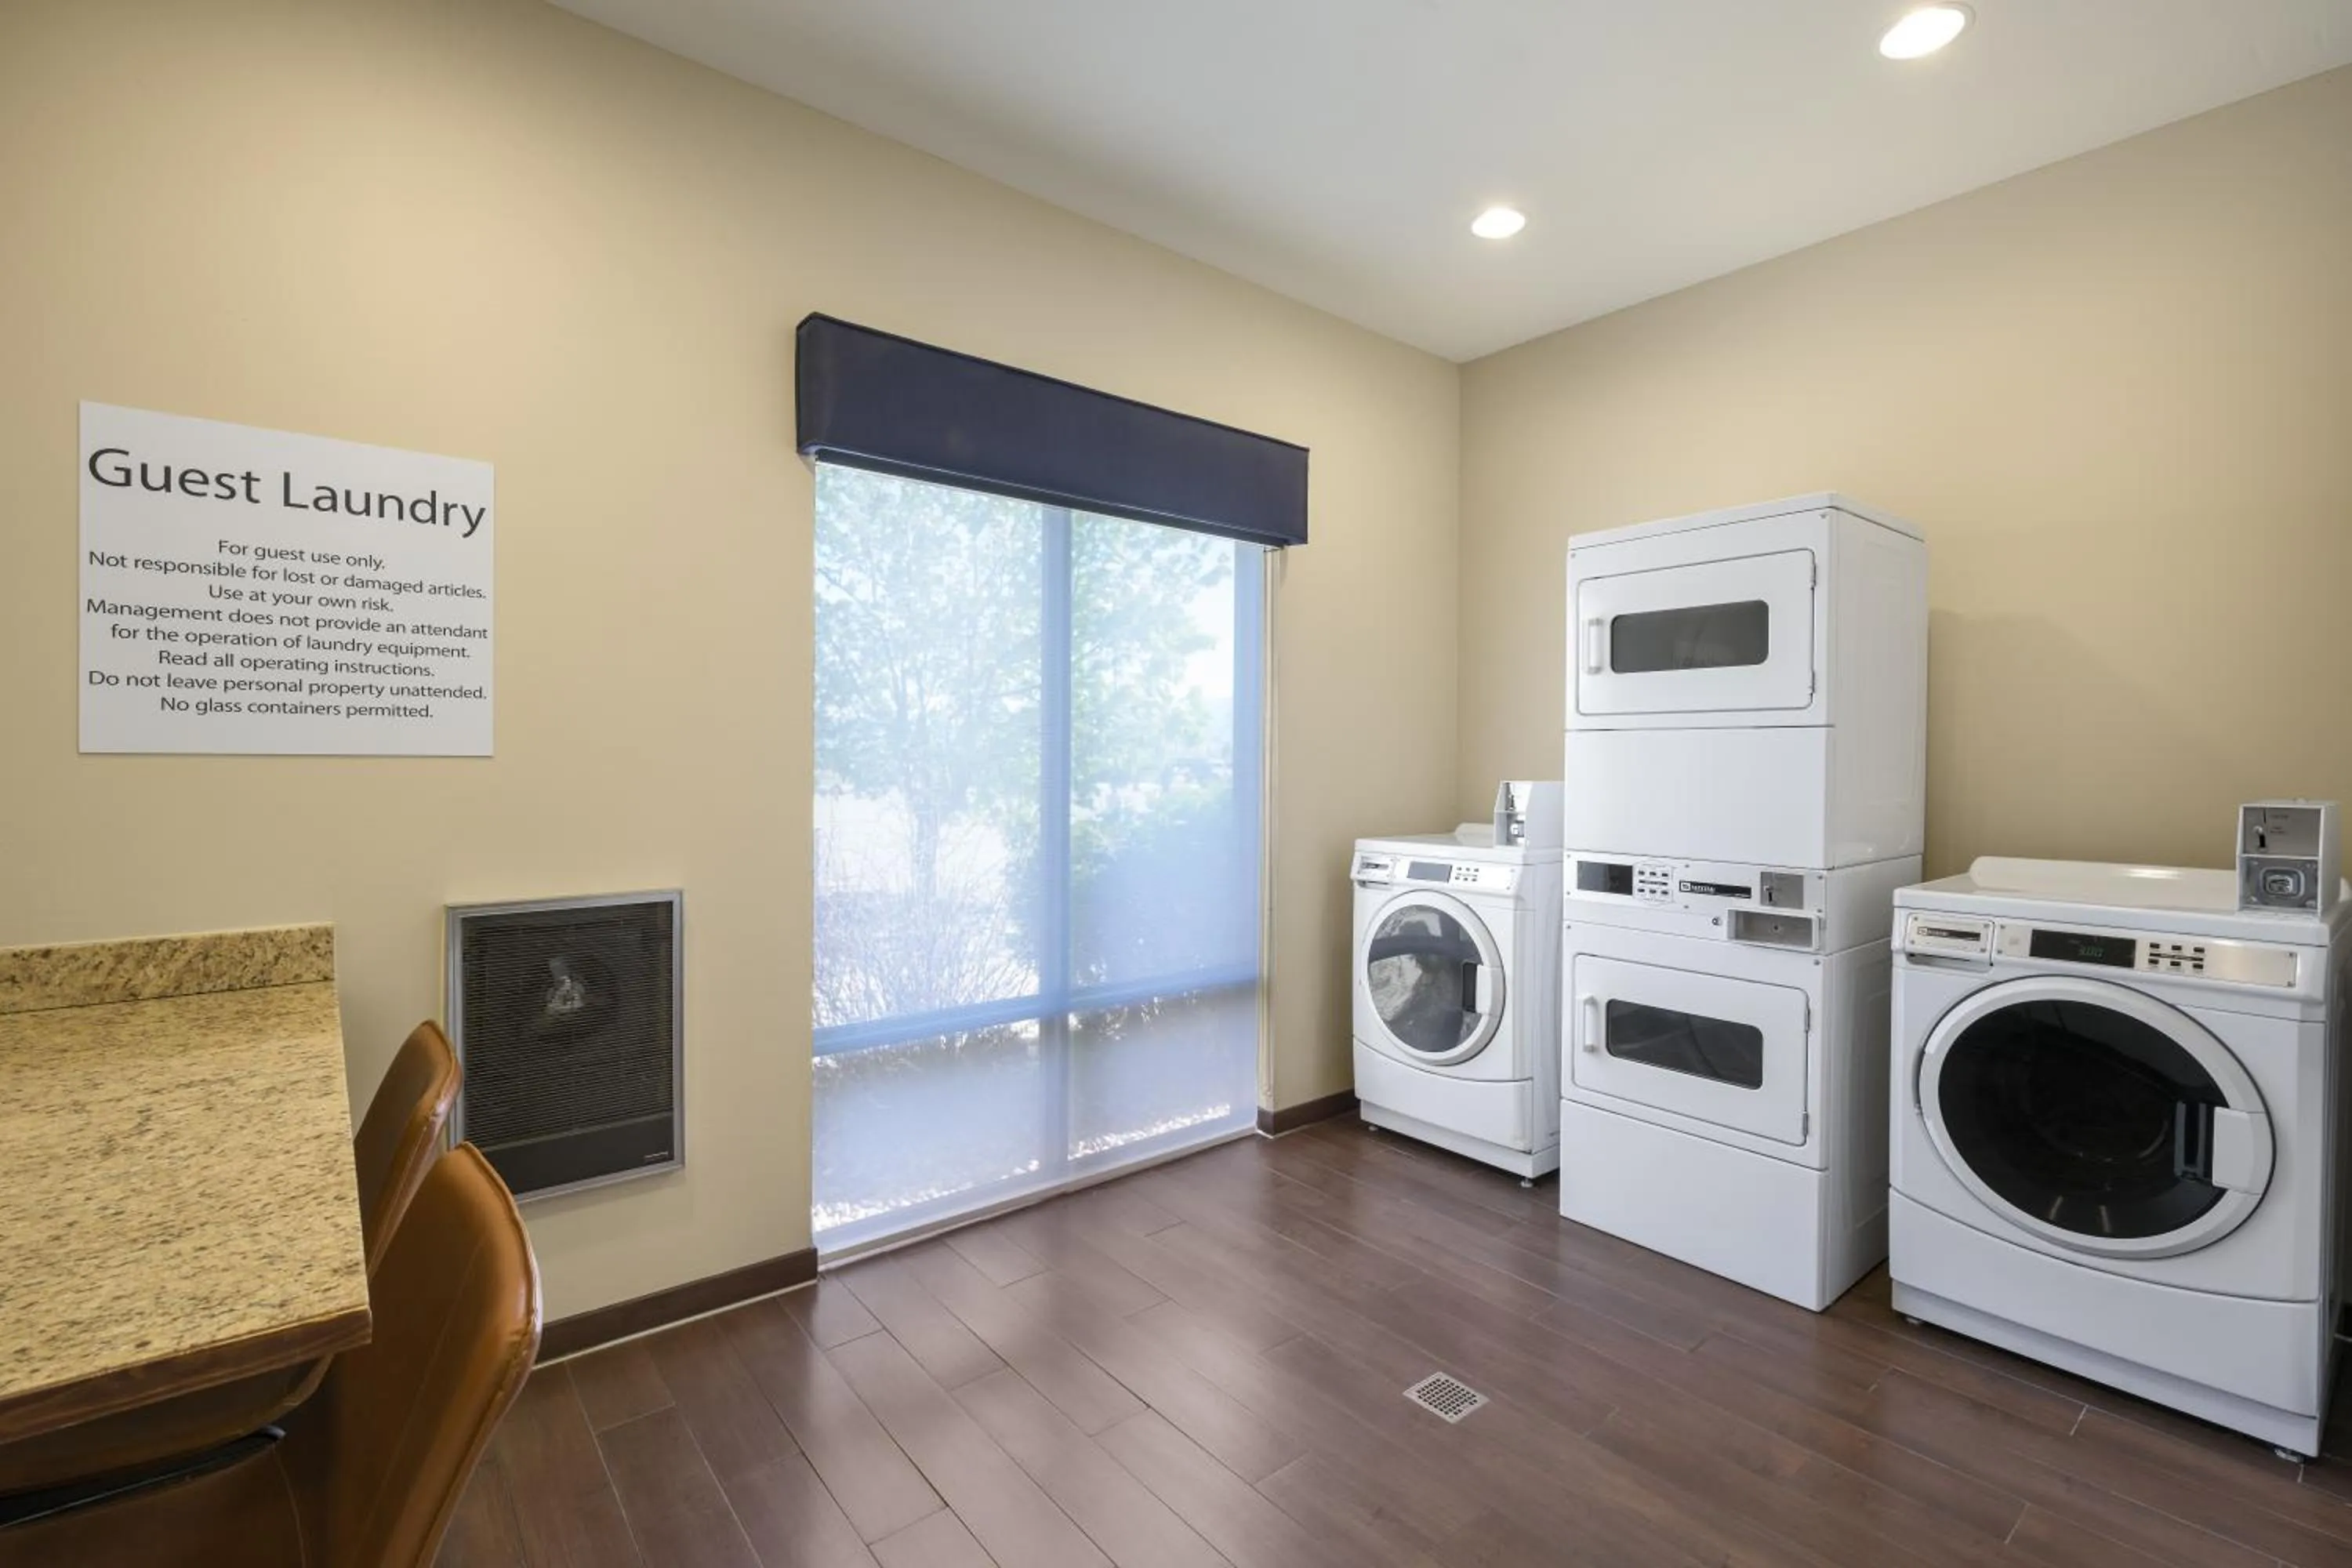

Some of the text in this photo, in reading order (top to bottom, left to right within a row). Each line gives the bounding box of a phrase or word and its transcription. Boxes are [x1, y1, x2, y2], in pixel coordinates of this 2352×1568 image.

[88, 448, 486, 539] Guest Laundry
[218, 539, 386, 572] For guest use only.
[89, 550, 487, 600] Not responsible for lost or damaged articles.
[209, 584, 394, 612] Use at your own risk.
[86, 598, 488, 640] Management does not provide an attendant
[111, 622, 470, 659] for the operation of laundry equipment.
[158, 649, 435, 677] Read all operating instructions.
[89, 670, 487, 700] Do not leave personal property unattended.
[160, 696, 434, 719] No glass containers permitted.
